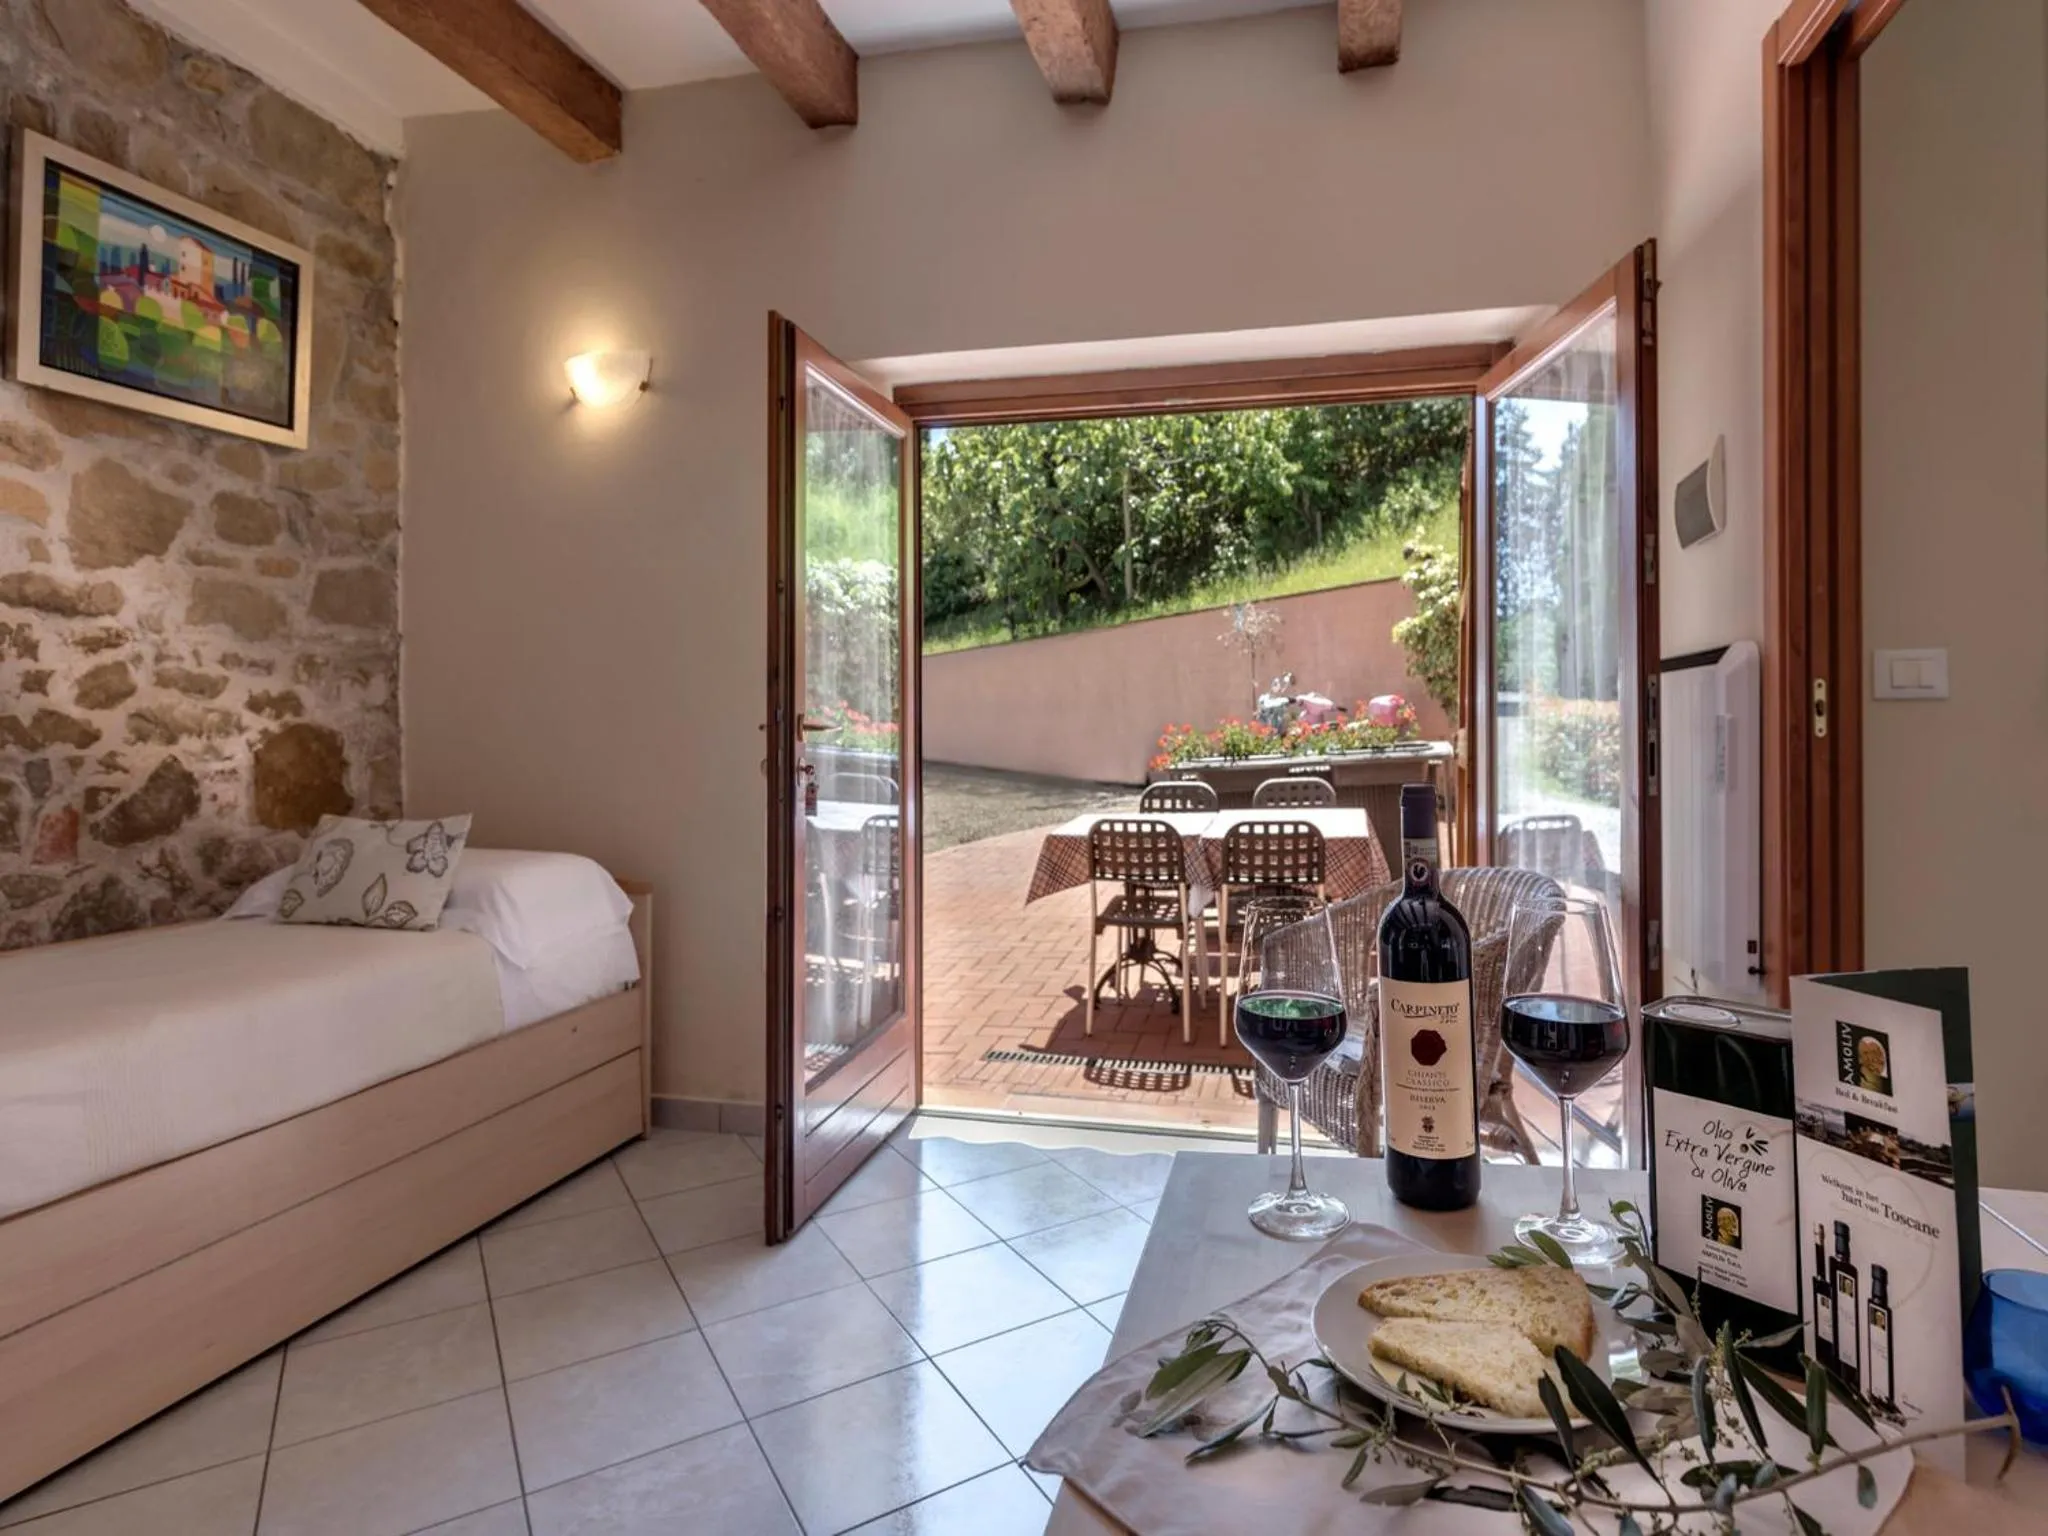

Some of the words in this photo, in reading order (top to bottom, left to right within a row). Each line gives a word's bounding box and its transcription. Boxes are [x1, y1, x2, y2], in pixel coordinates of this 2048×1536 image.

[1390, 998, 1459, 1016] CARPINETO
[1406, 1077, 1450, 1087] CLASSICO
[1409, 1094, 1448, 1104] RISERVA
[1702, 1119, 1734, 1141] Olio
[1664, 1129, 1709, 1157] Extra
[1714, 1143, 1776, 1179] Vergine
[1711, 1167, 1748, 1192] Oliva
[1821, 1173, 1854, 1194] Welkom
[1841, 1190, 1863, 1208] hart
[1880, 1202, 1941, 1239] Toscane
